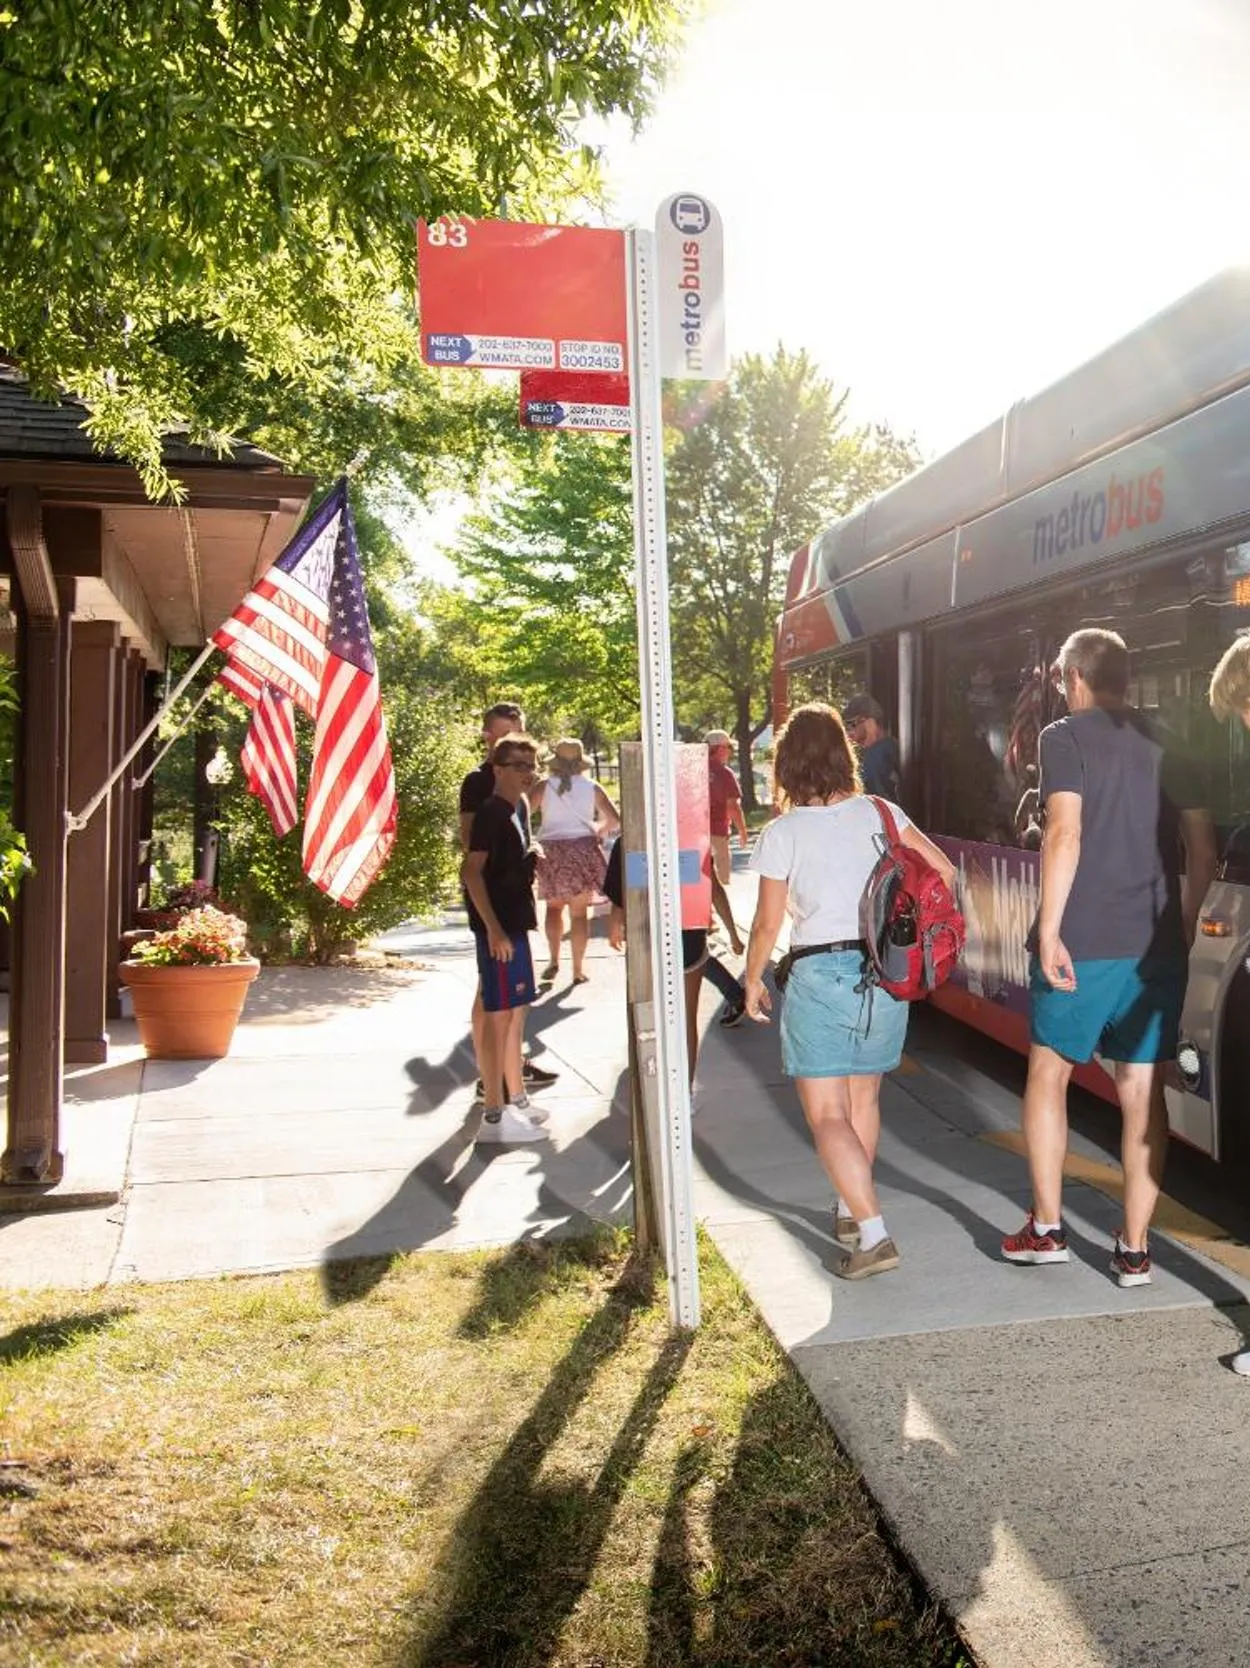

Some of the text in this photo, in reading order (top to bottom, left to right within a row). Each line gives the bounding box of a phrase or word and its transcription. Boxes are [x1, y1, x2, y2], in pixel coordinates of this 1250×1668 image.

[428, 222, 468, 247] 83
[679, 240, 703, 370] metrobus
[430, 336, 463, 348] NEXT
[561, 343, 588, 353] STOP
[434, 349, 460, 361] BUS
[479, 352, 553, 365] WMATA.COM
[561, 354, 621, 369] 3002453
[527, 402, 557, 413] NEXT
[530, 414, 553, 425] BUS
[1033, 465, 1166, 565] metrobus
